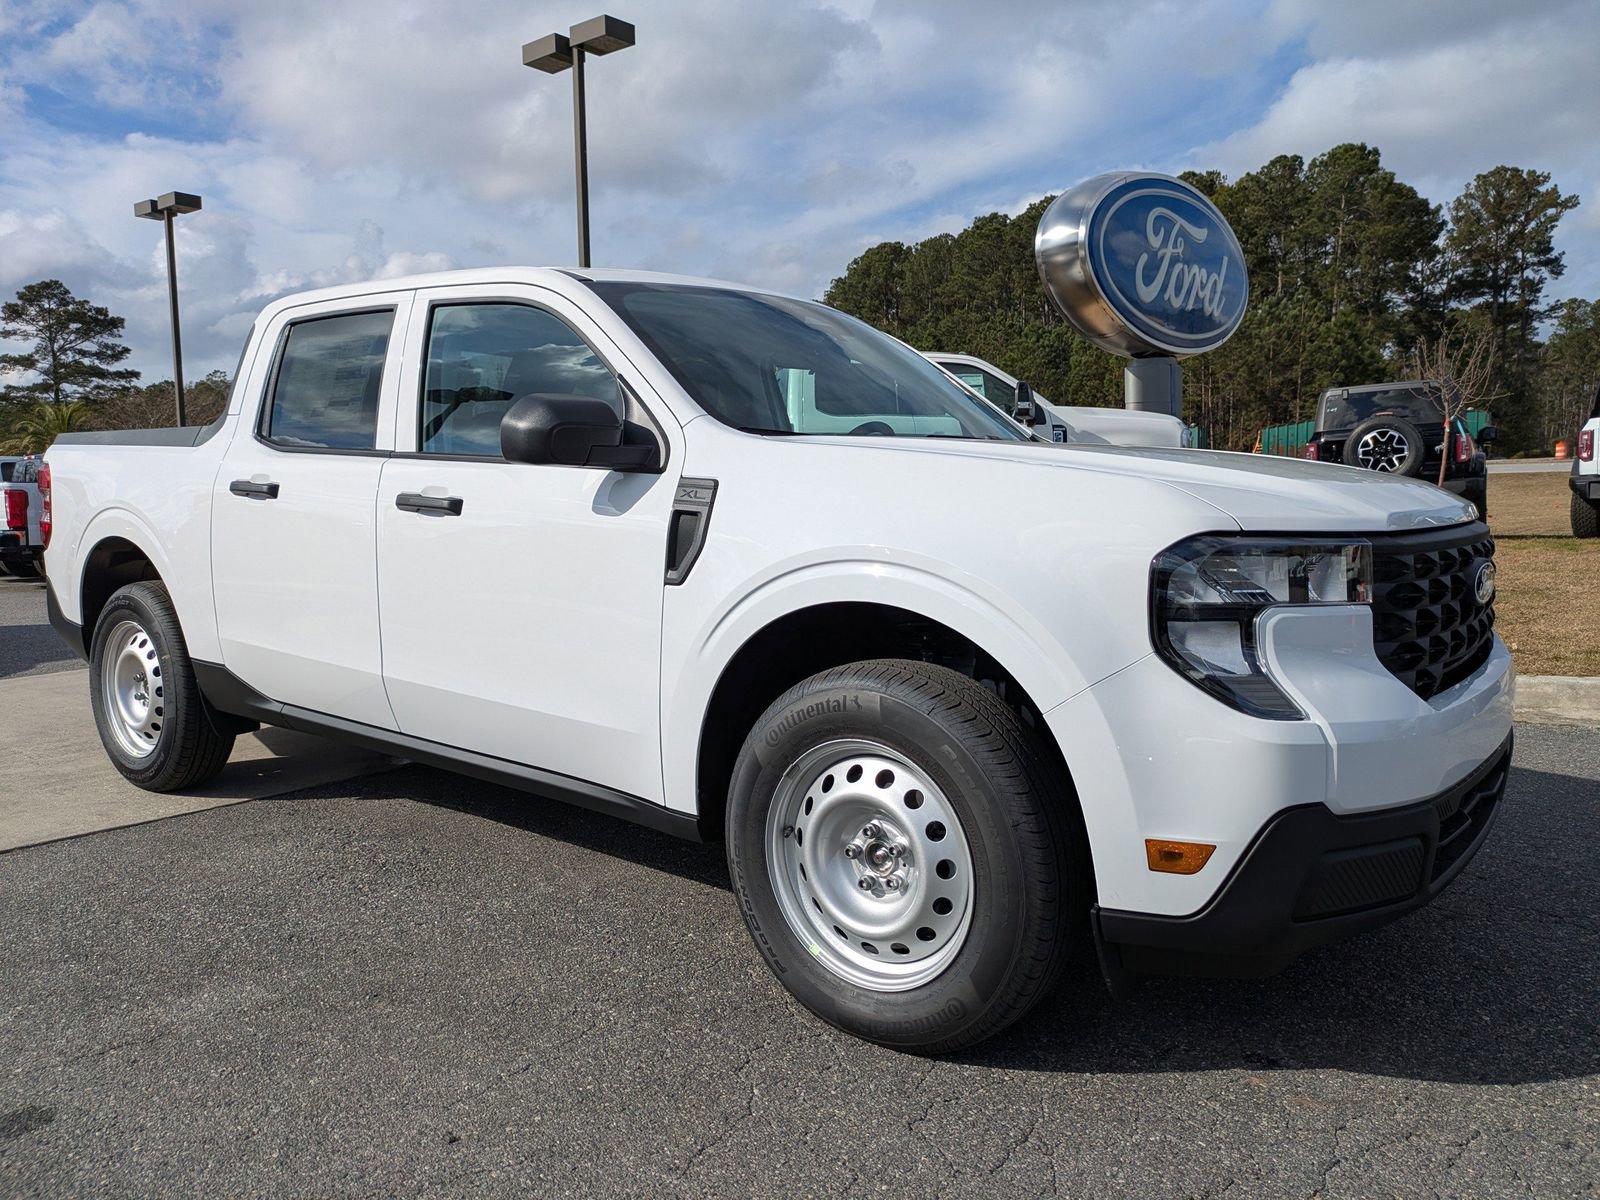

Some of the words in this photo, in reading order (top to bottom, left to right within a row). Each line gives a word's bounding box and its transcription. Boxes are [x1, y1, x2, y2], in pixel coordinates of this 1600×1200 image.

[1136, 206, 1228, 317] Ford
[680, 488, 706, 500] XL
[764, 695, 848, 748] Continental
